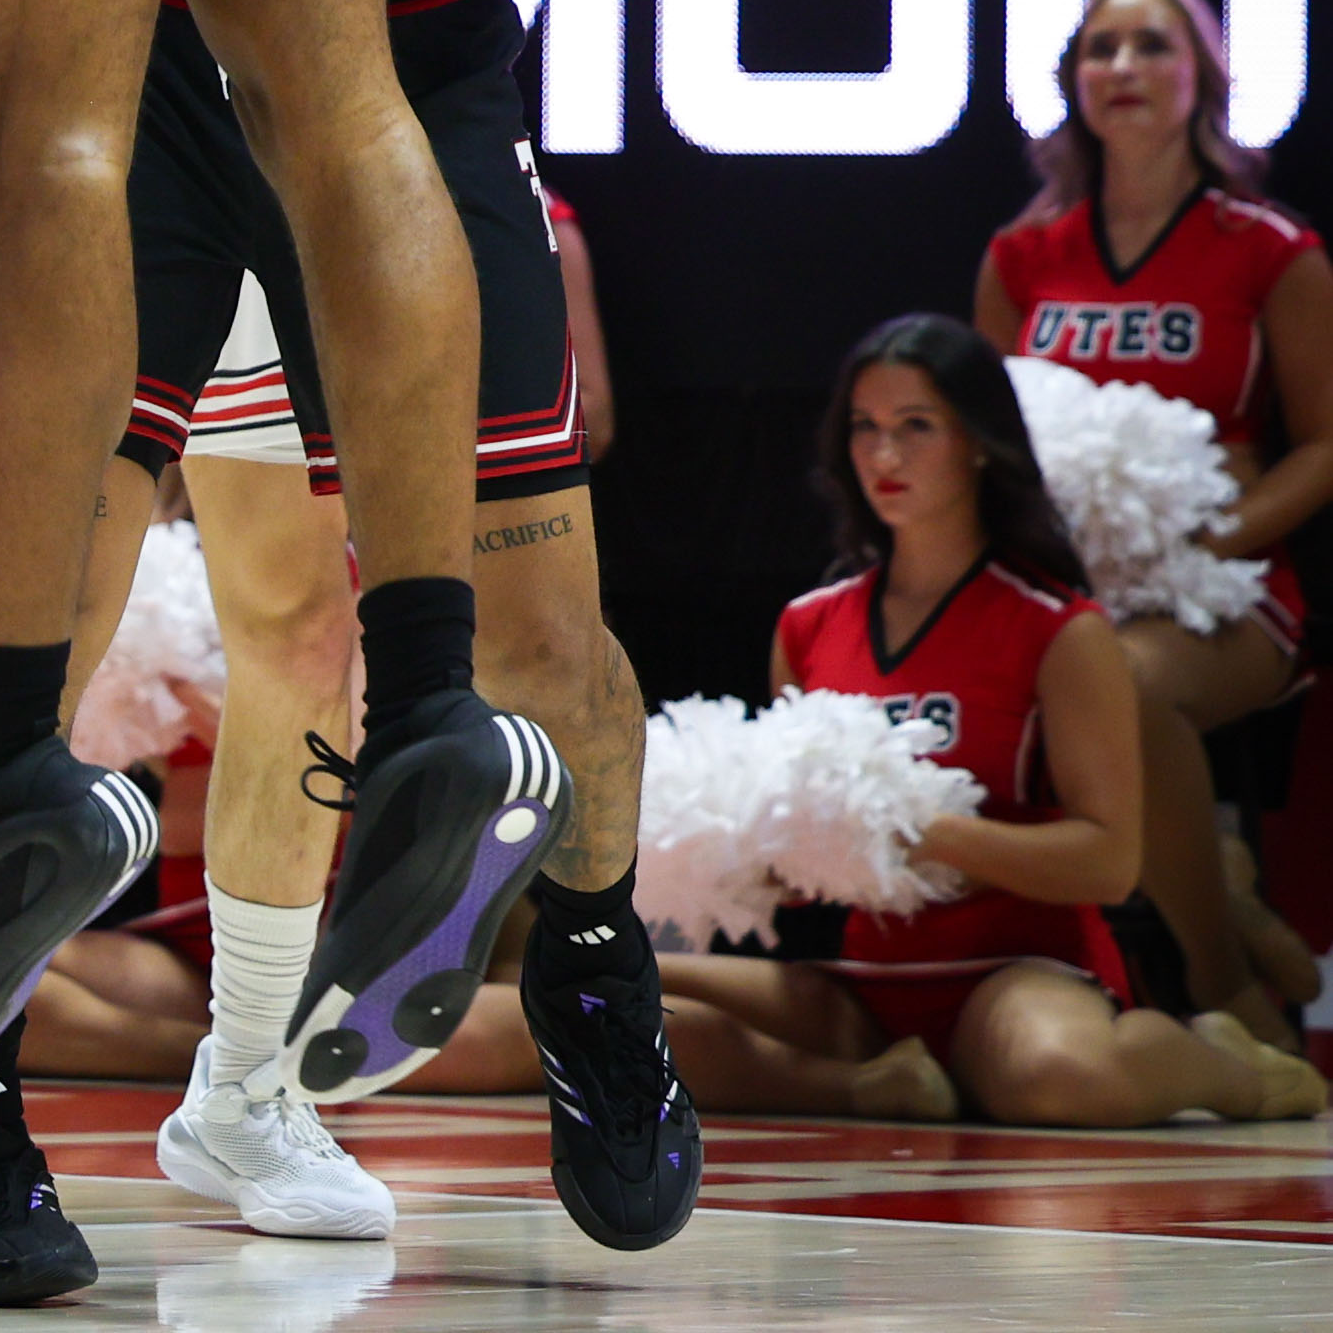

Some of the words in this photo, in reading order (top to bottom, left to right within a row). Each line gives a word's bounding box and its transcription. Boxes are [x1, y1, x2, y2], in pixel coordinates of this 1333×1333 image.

[1026, 300, 1206, 364] UTES
[472, 513, 573, 555] ACRIFICE
[880, 691, 963, 753] ES
